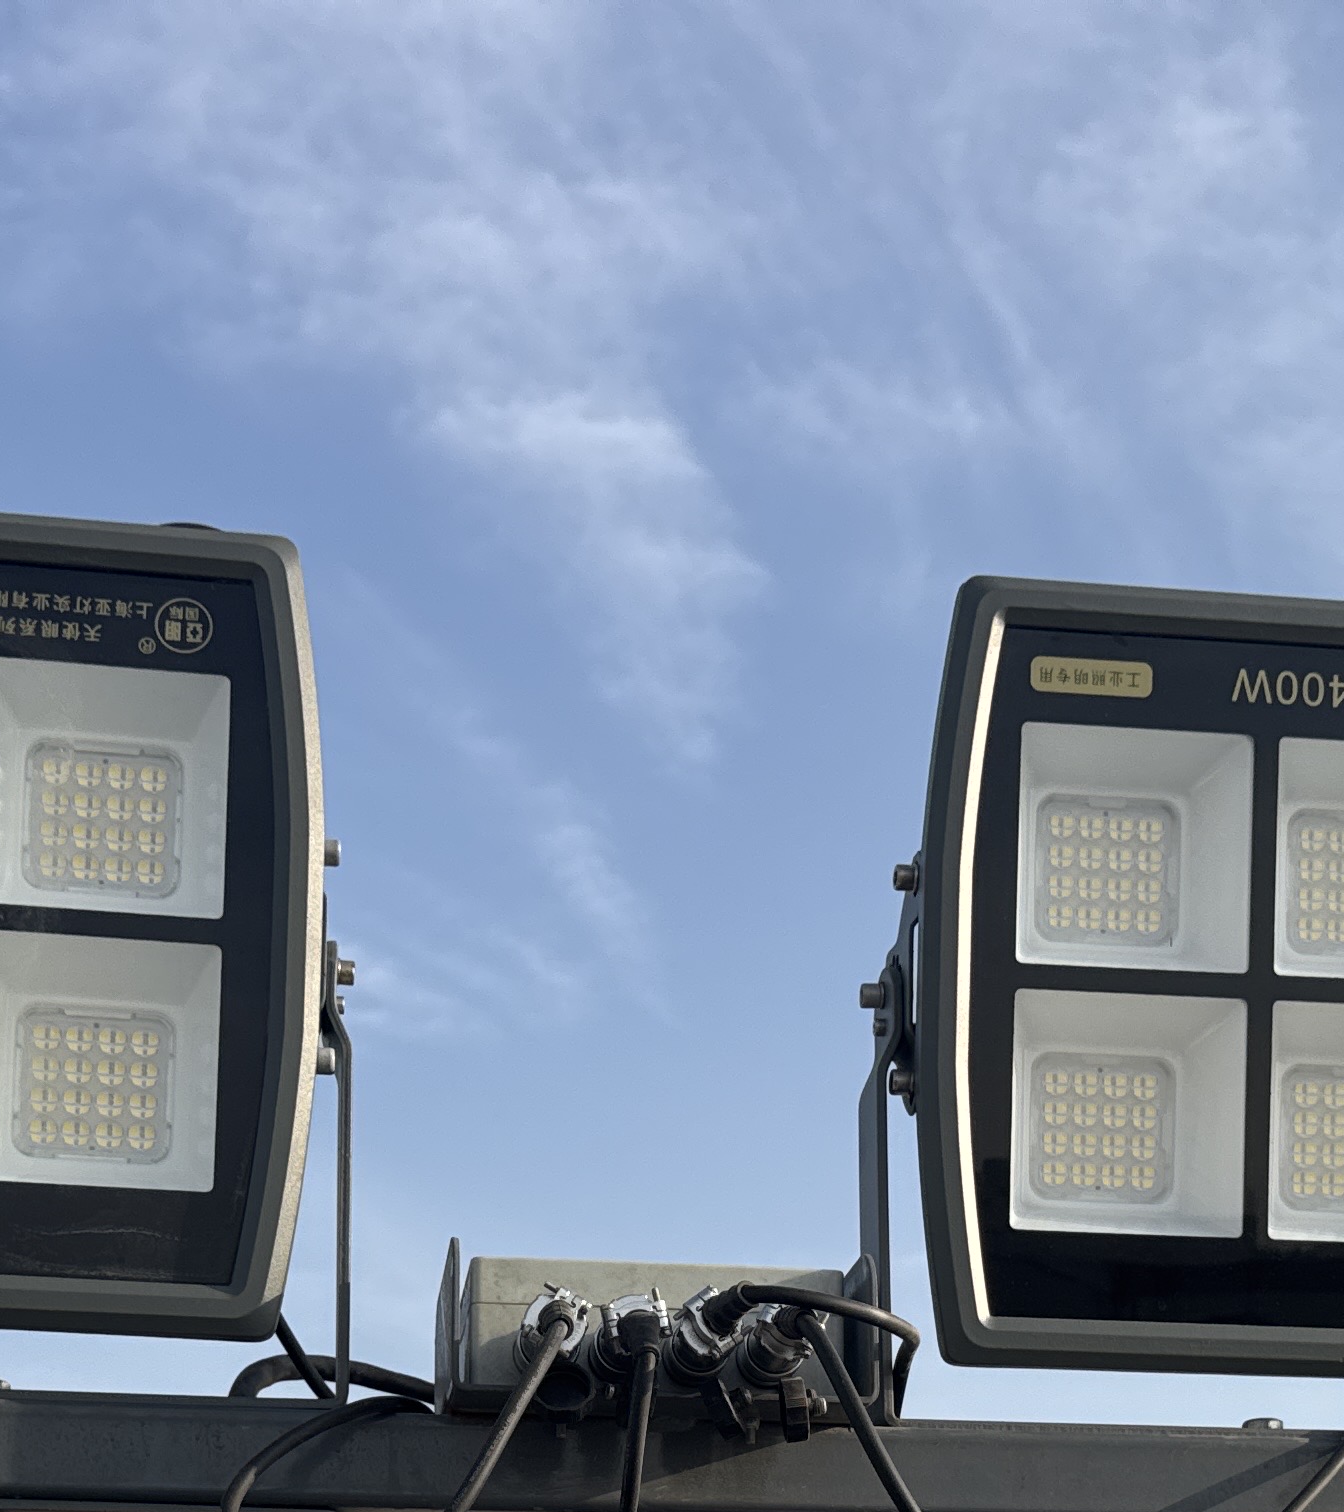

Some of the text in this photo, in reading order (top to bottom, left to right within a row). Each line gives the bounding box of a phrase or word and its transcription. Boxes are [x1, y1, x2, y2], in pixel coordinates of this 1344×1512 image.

[1039, 666, 1141, 688] 工业照明专用
